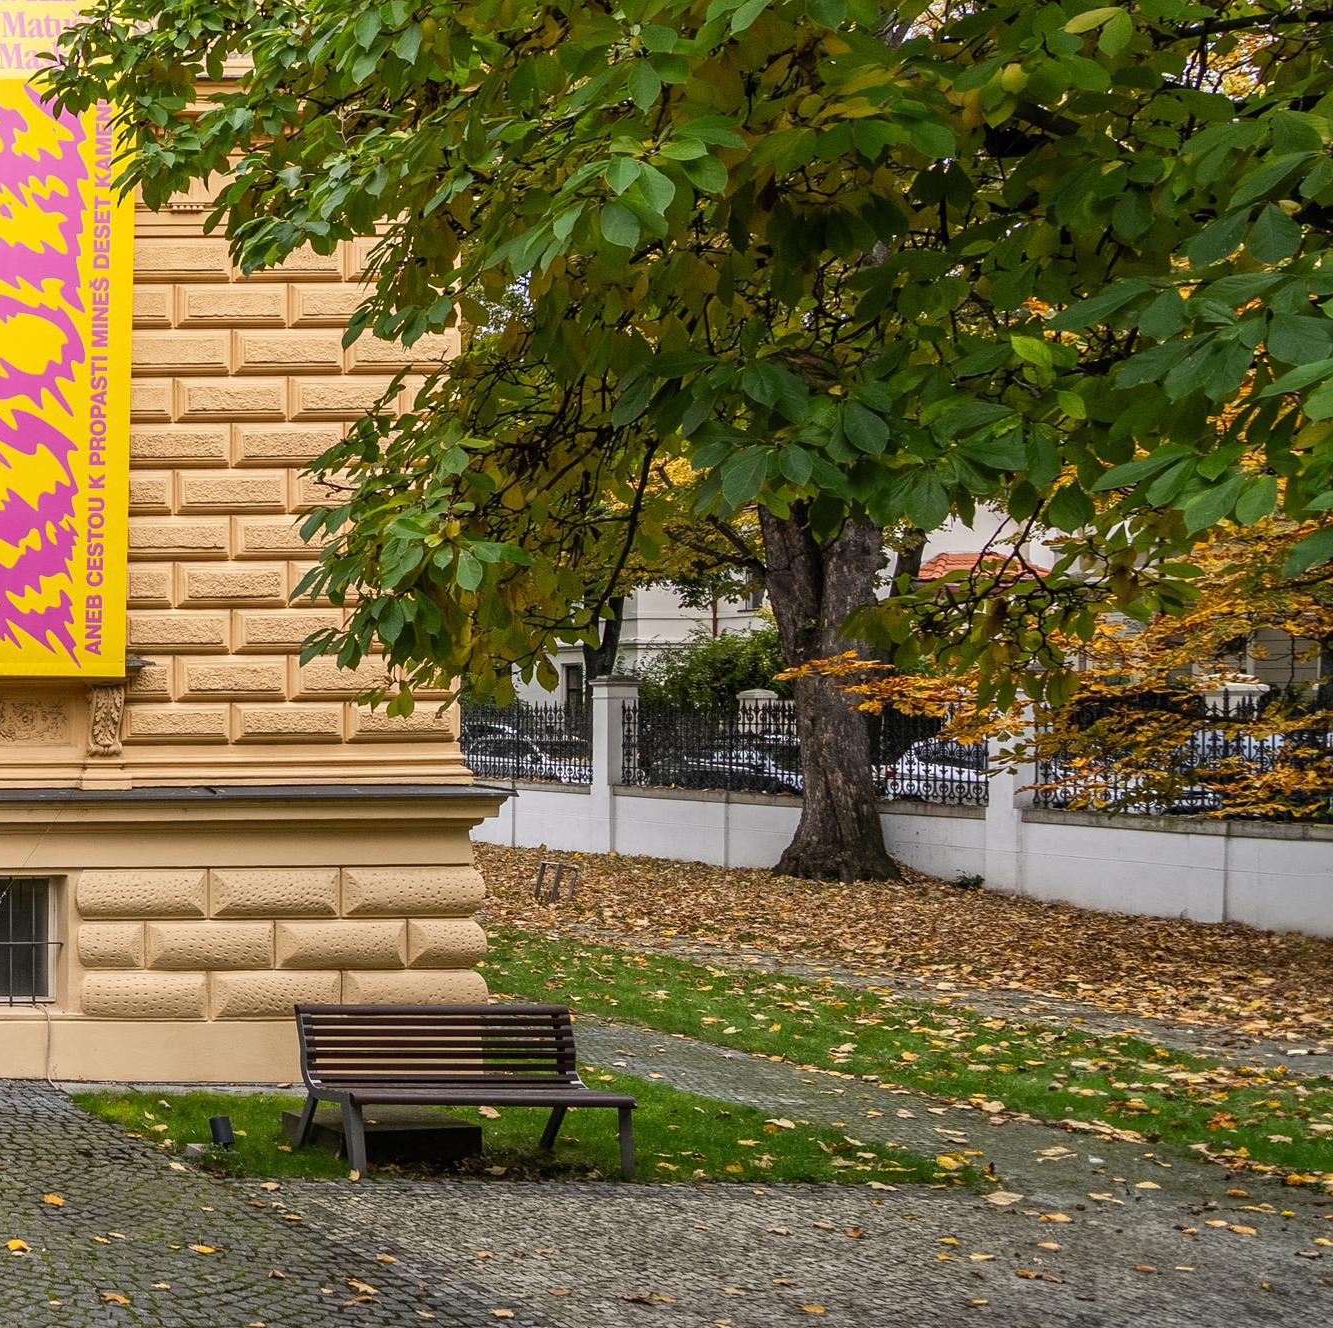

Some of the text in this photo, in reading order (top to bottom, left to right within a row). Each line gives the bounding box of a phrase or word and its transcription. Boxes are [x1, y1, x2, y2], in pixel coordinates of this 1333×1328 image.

[85, 99, 113, 656] ANEB CESTOU K PROPASTI MINEŠ DESET KAMEN
